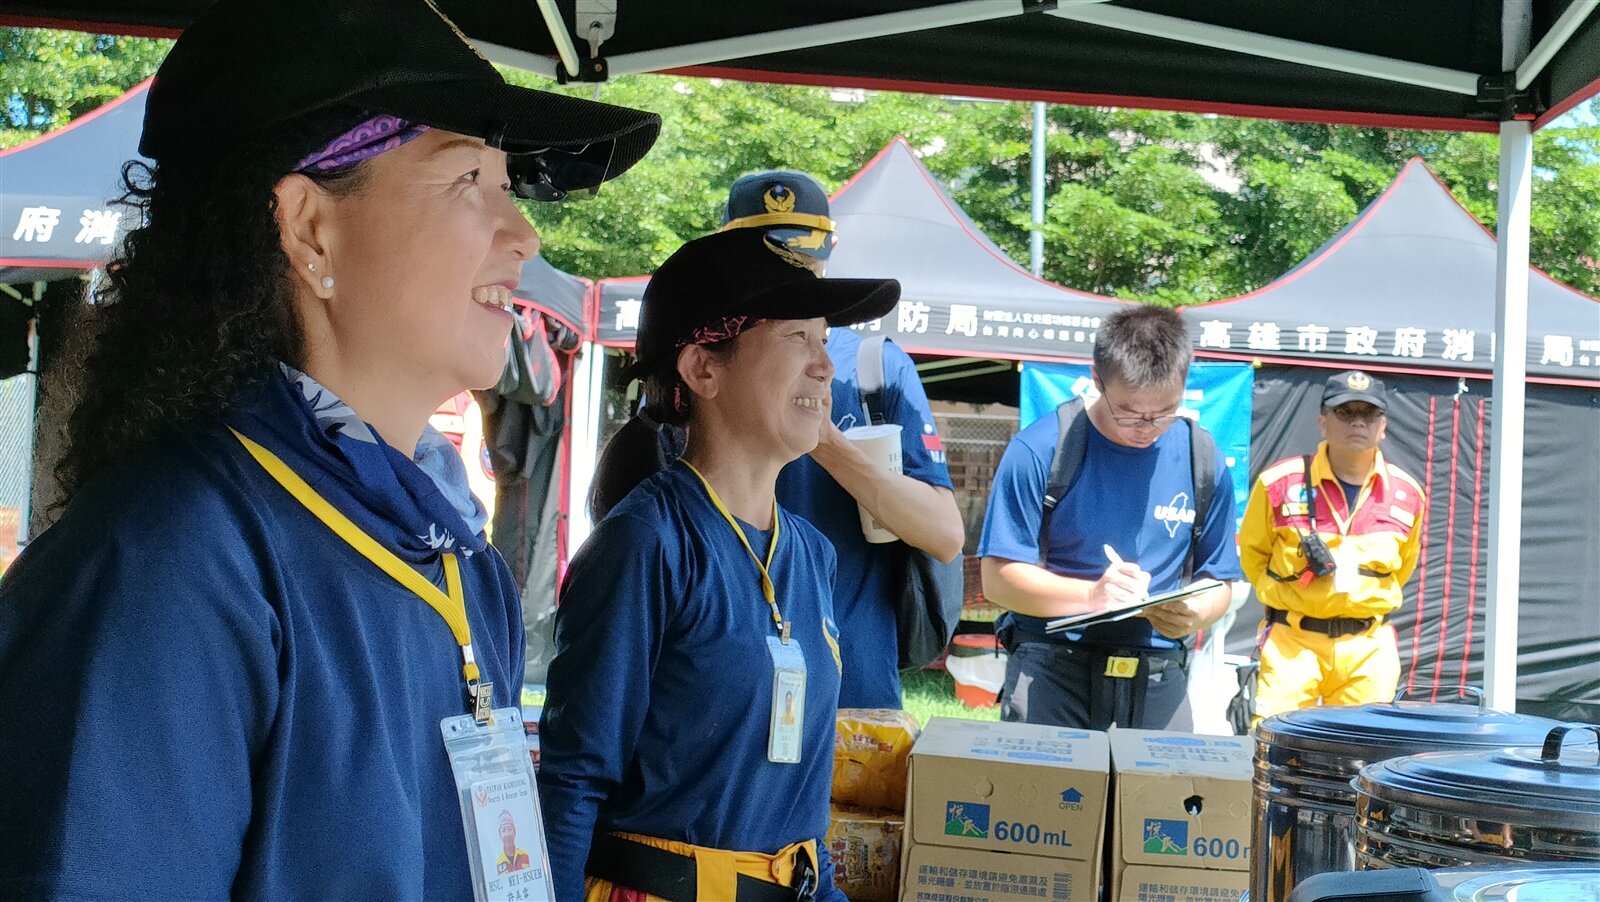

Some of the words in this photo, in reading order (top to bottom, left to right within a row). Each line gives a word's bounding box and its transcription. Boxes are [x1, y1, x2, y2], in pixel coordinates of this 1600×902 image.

[1199, 320, 1574, 367] 高雄市政府消局
[1058, 801, 1083, 812] OPEN
